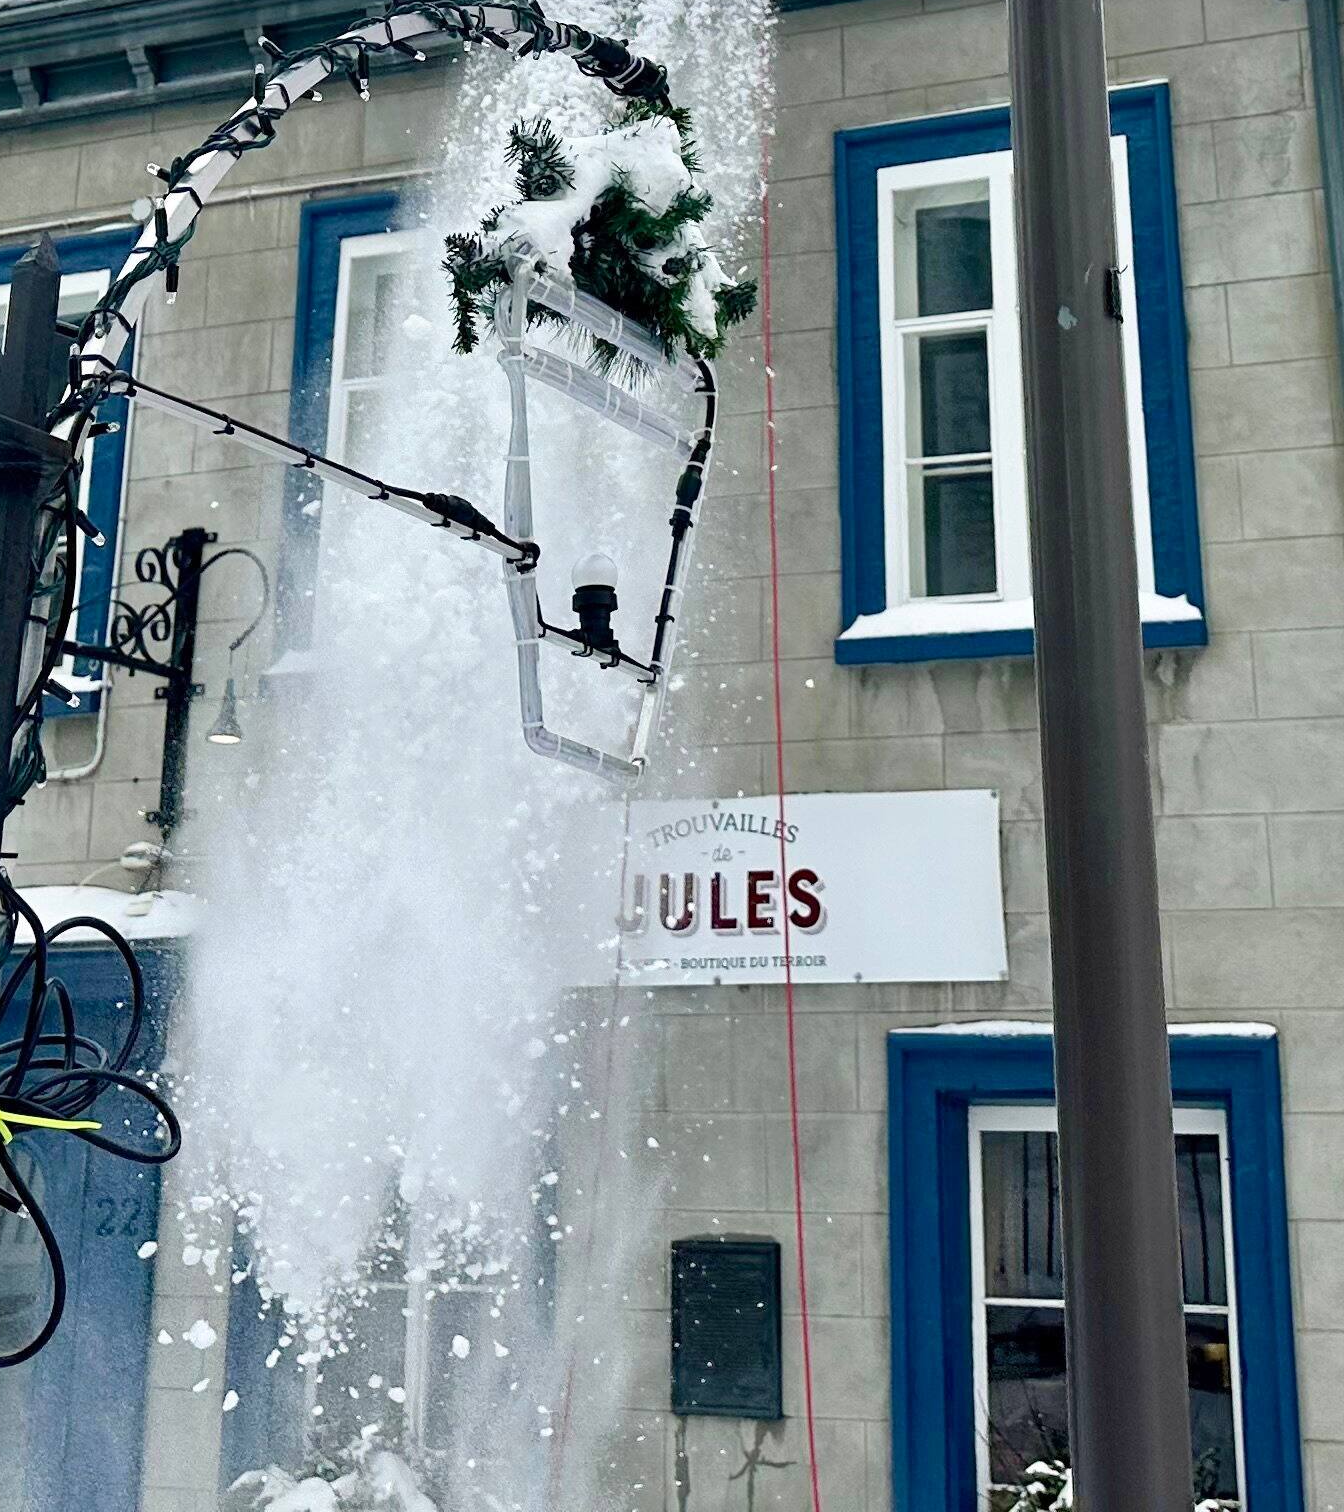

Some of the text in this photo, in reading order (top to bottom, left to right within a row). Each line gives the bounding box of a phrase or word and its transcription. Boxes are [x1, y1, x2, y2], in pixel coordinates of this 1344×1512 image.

[647, 812, 800, 847] TROUVAILLES
[616, 868, 826, 935] JULES
[680, 956, 747, 970] BOUTIQUE
[749, 955, 769, 968] DU
